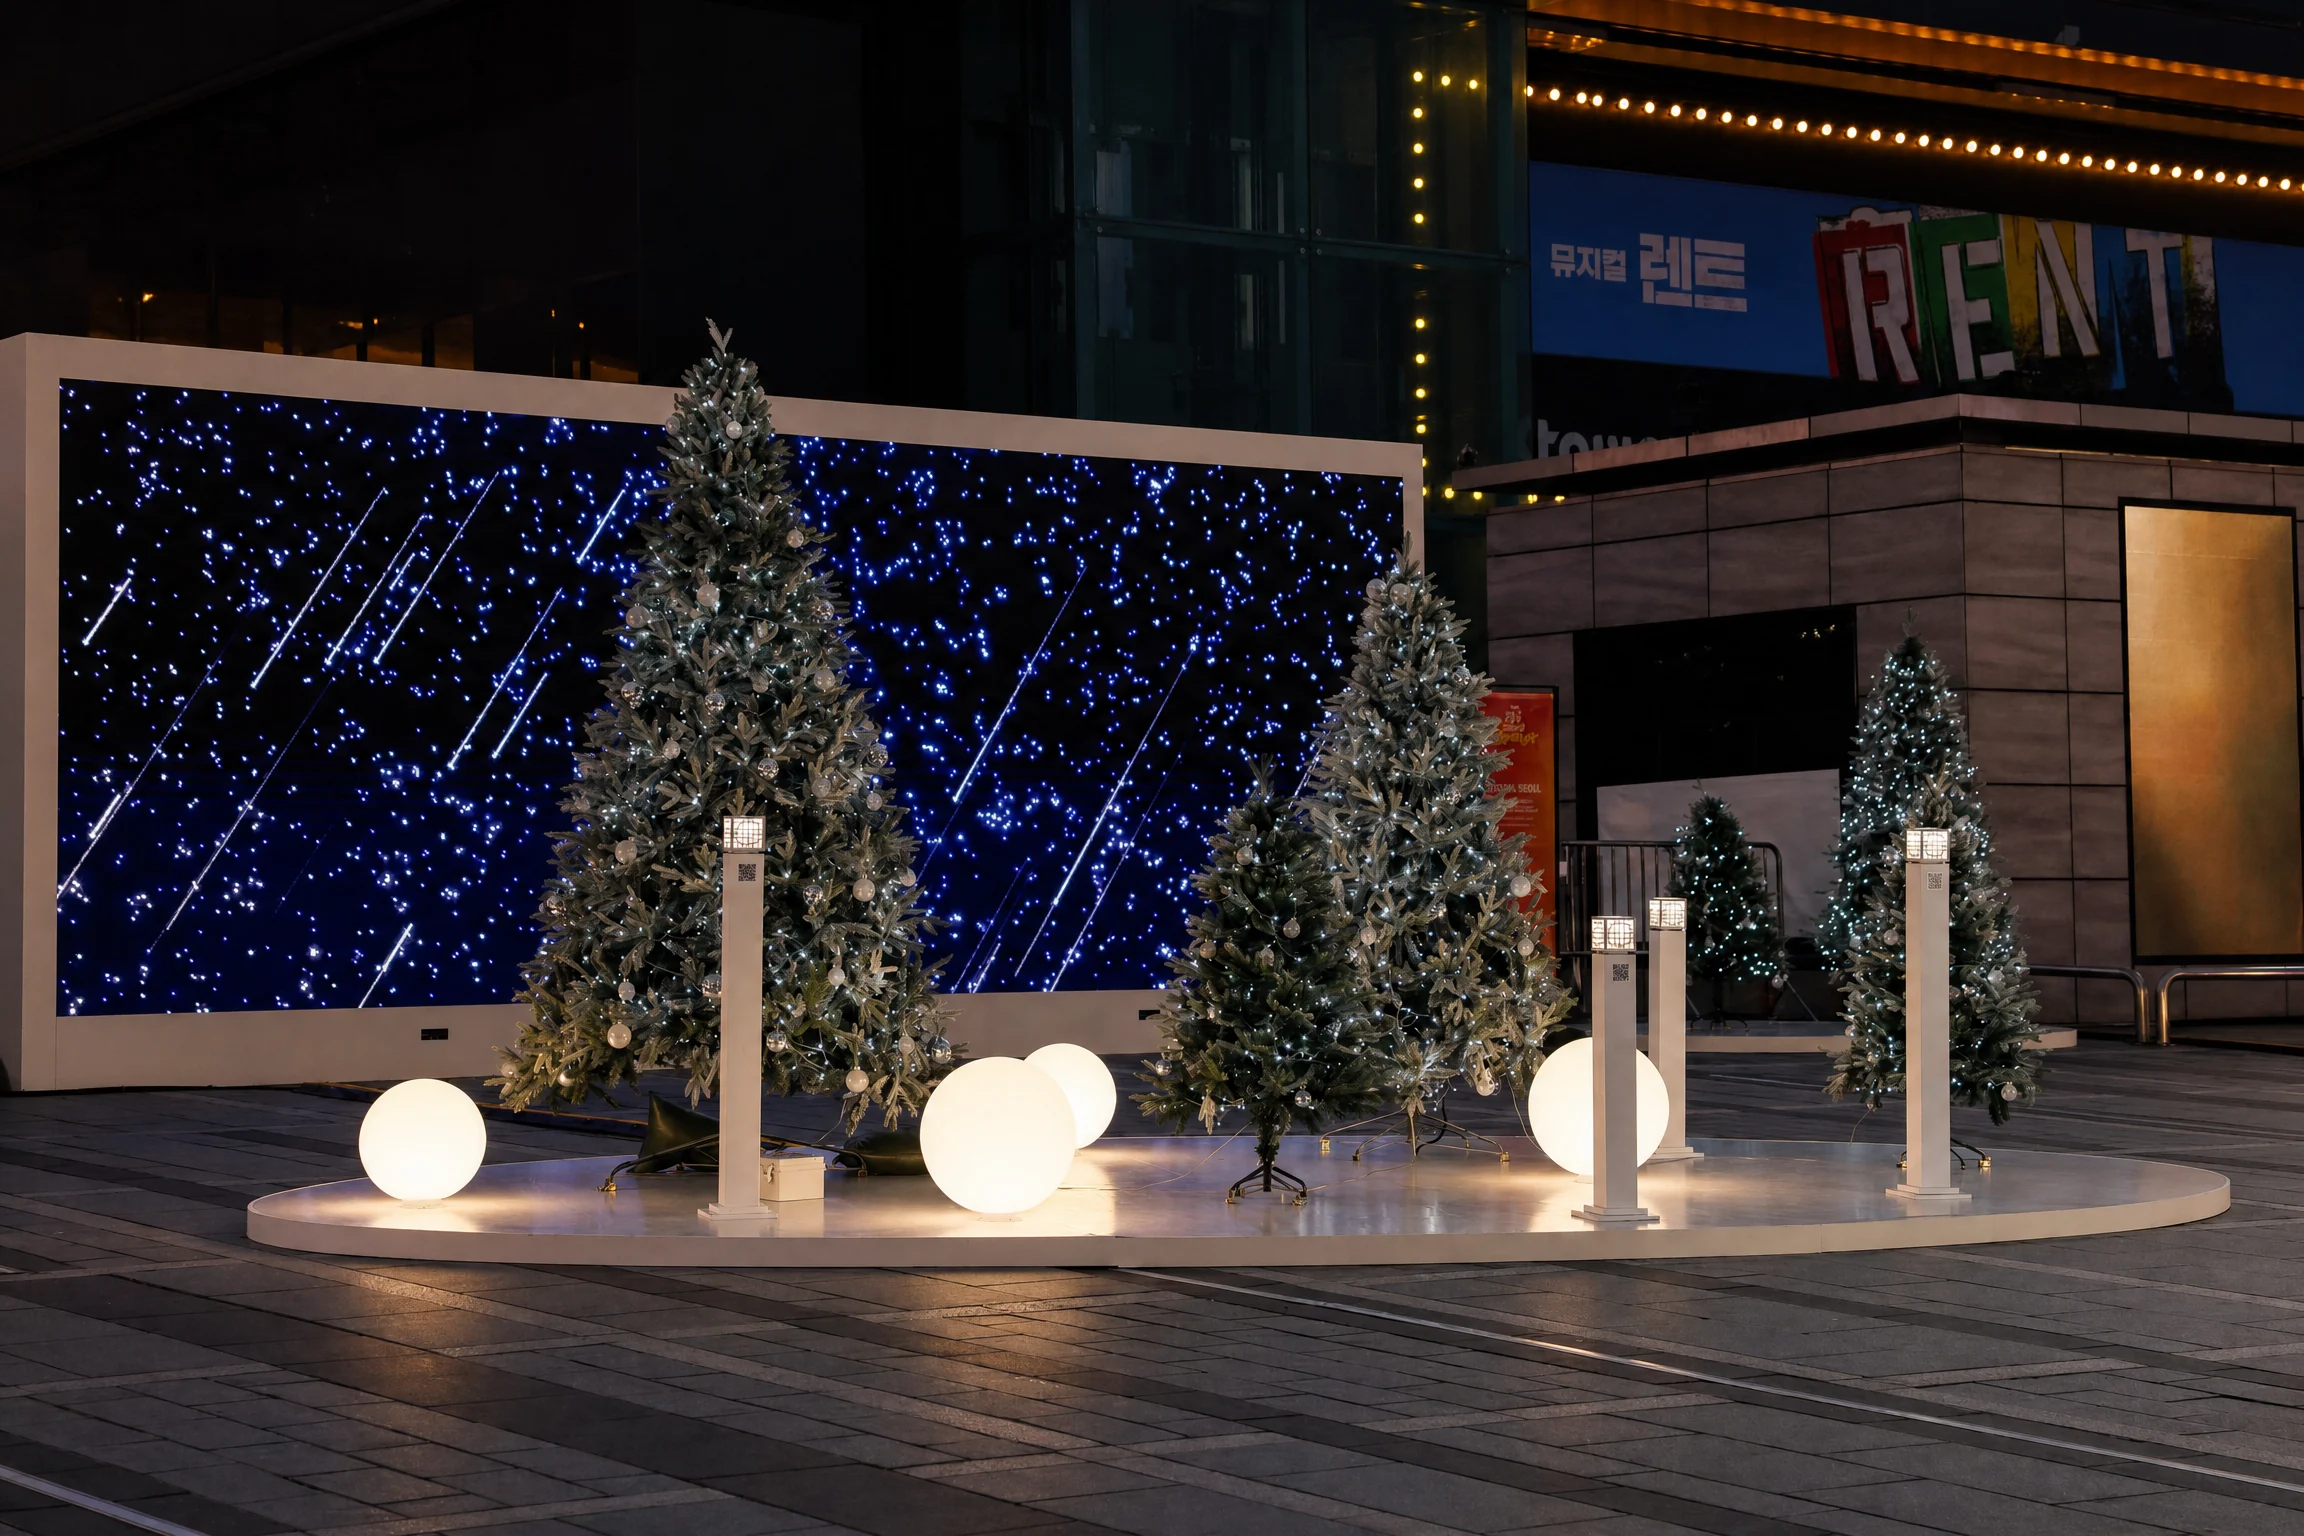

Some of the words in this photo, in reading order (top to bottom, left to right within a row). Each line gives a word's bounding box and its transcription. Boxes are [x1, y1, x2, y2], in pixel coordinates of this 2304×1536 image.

[1550, 243, 1627, 283] 뮤지컬
[1639, 232, 1748, 313] 렌트
[1842, 218, 2184, 384] RENT
